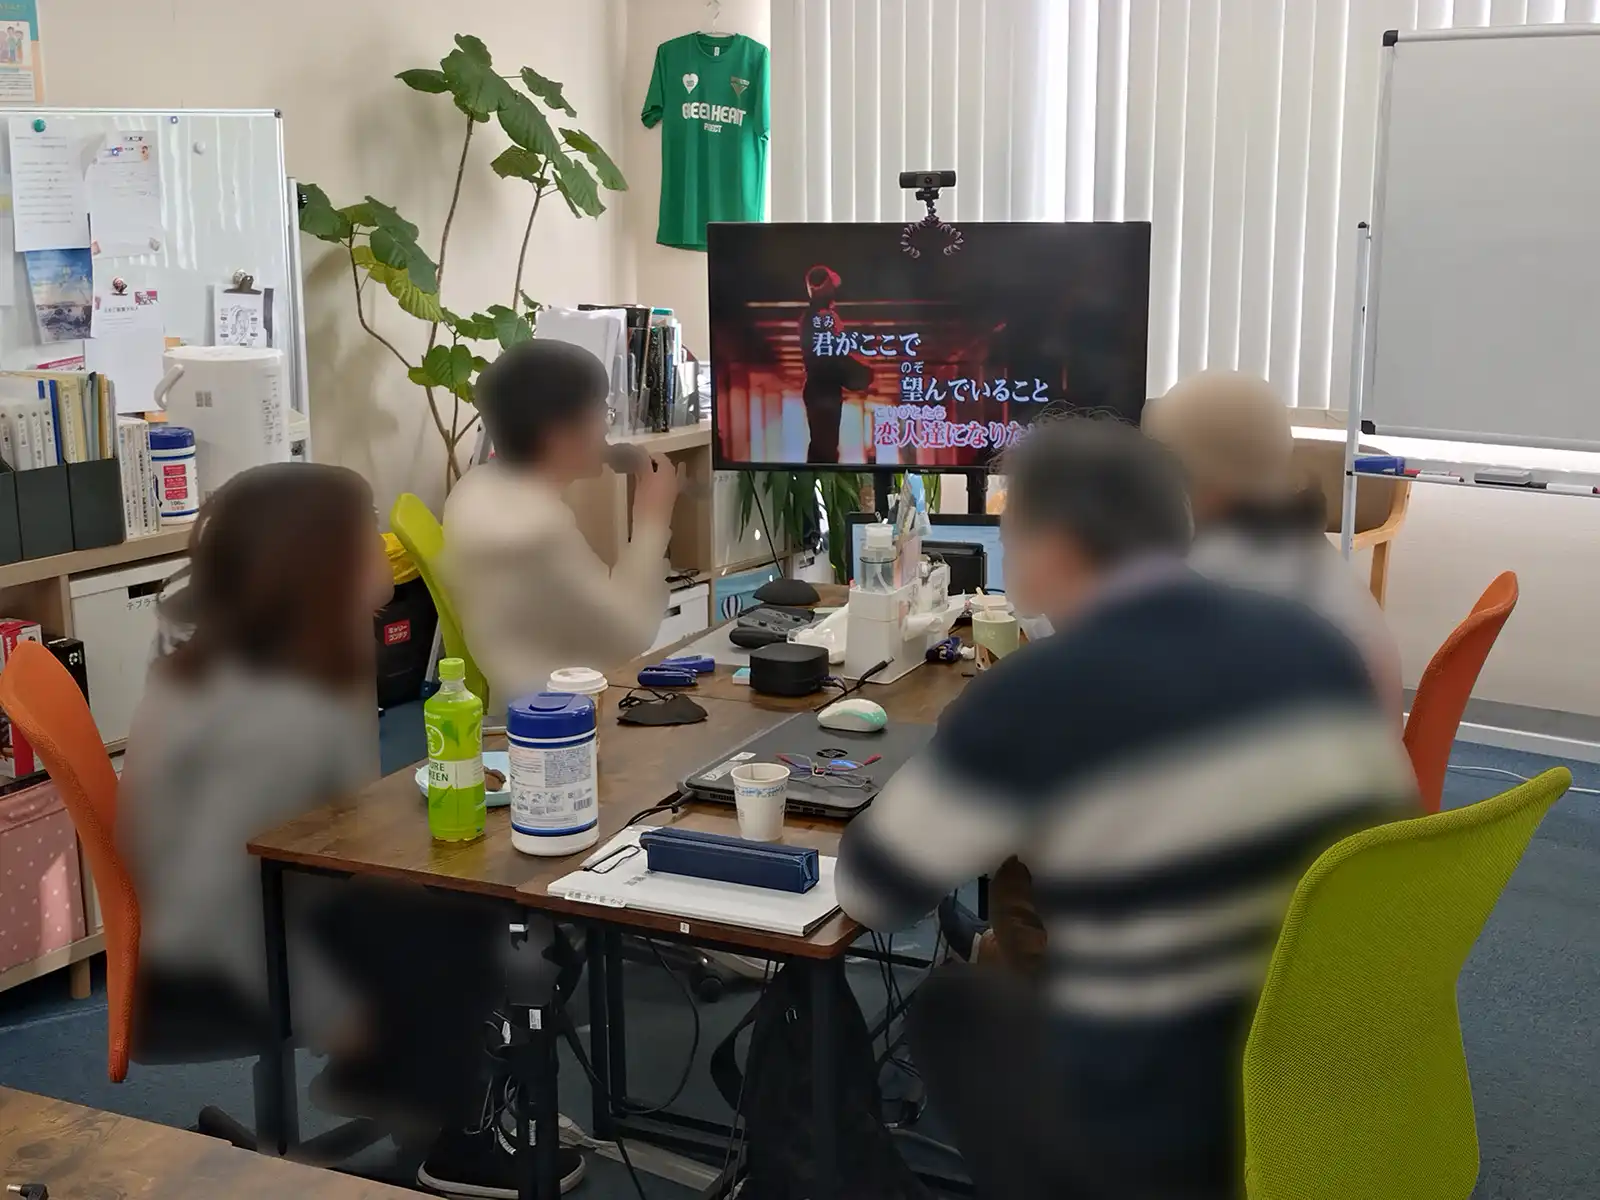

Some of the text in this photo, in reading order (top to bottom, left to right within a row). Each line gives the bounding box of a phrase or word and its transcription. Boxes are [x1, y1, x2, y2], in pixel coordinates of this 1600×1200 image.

[812, 315, 834, 328] きみ
[812, 331, 921, 356] 君がここで
[901, 360, 925, 374] のぞ
[901, 376, 1049, 402] 望んでいること
